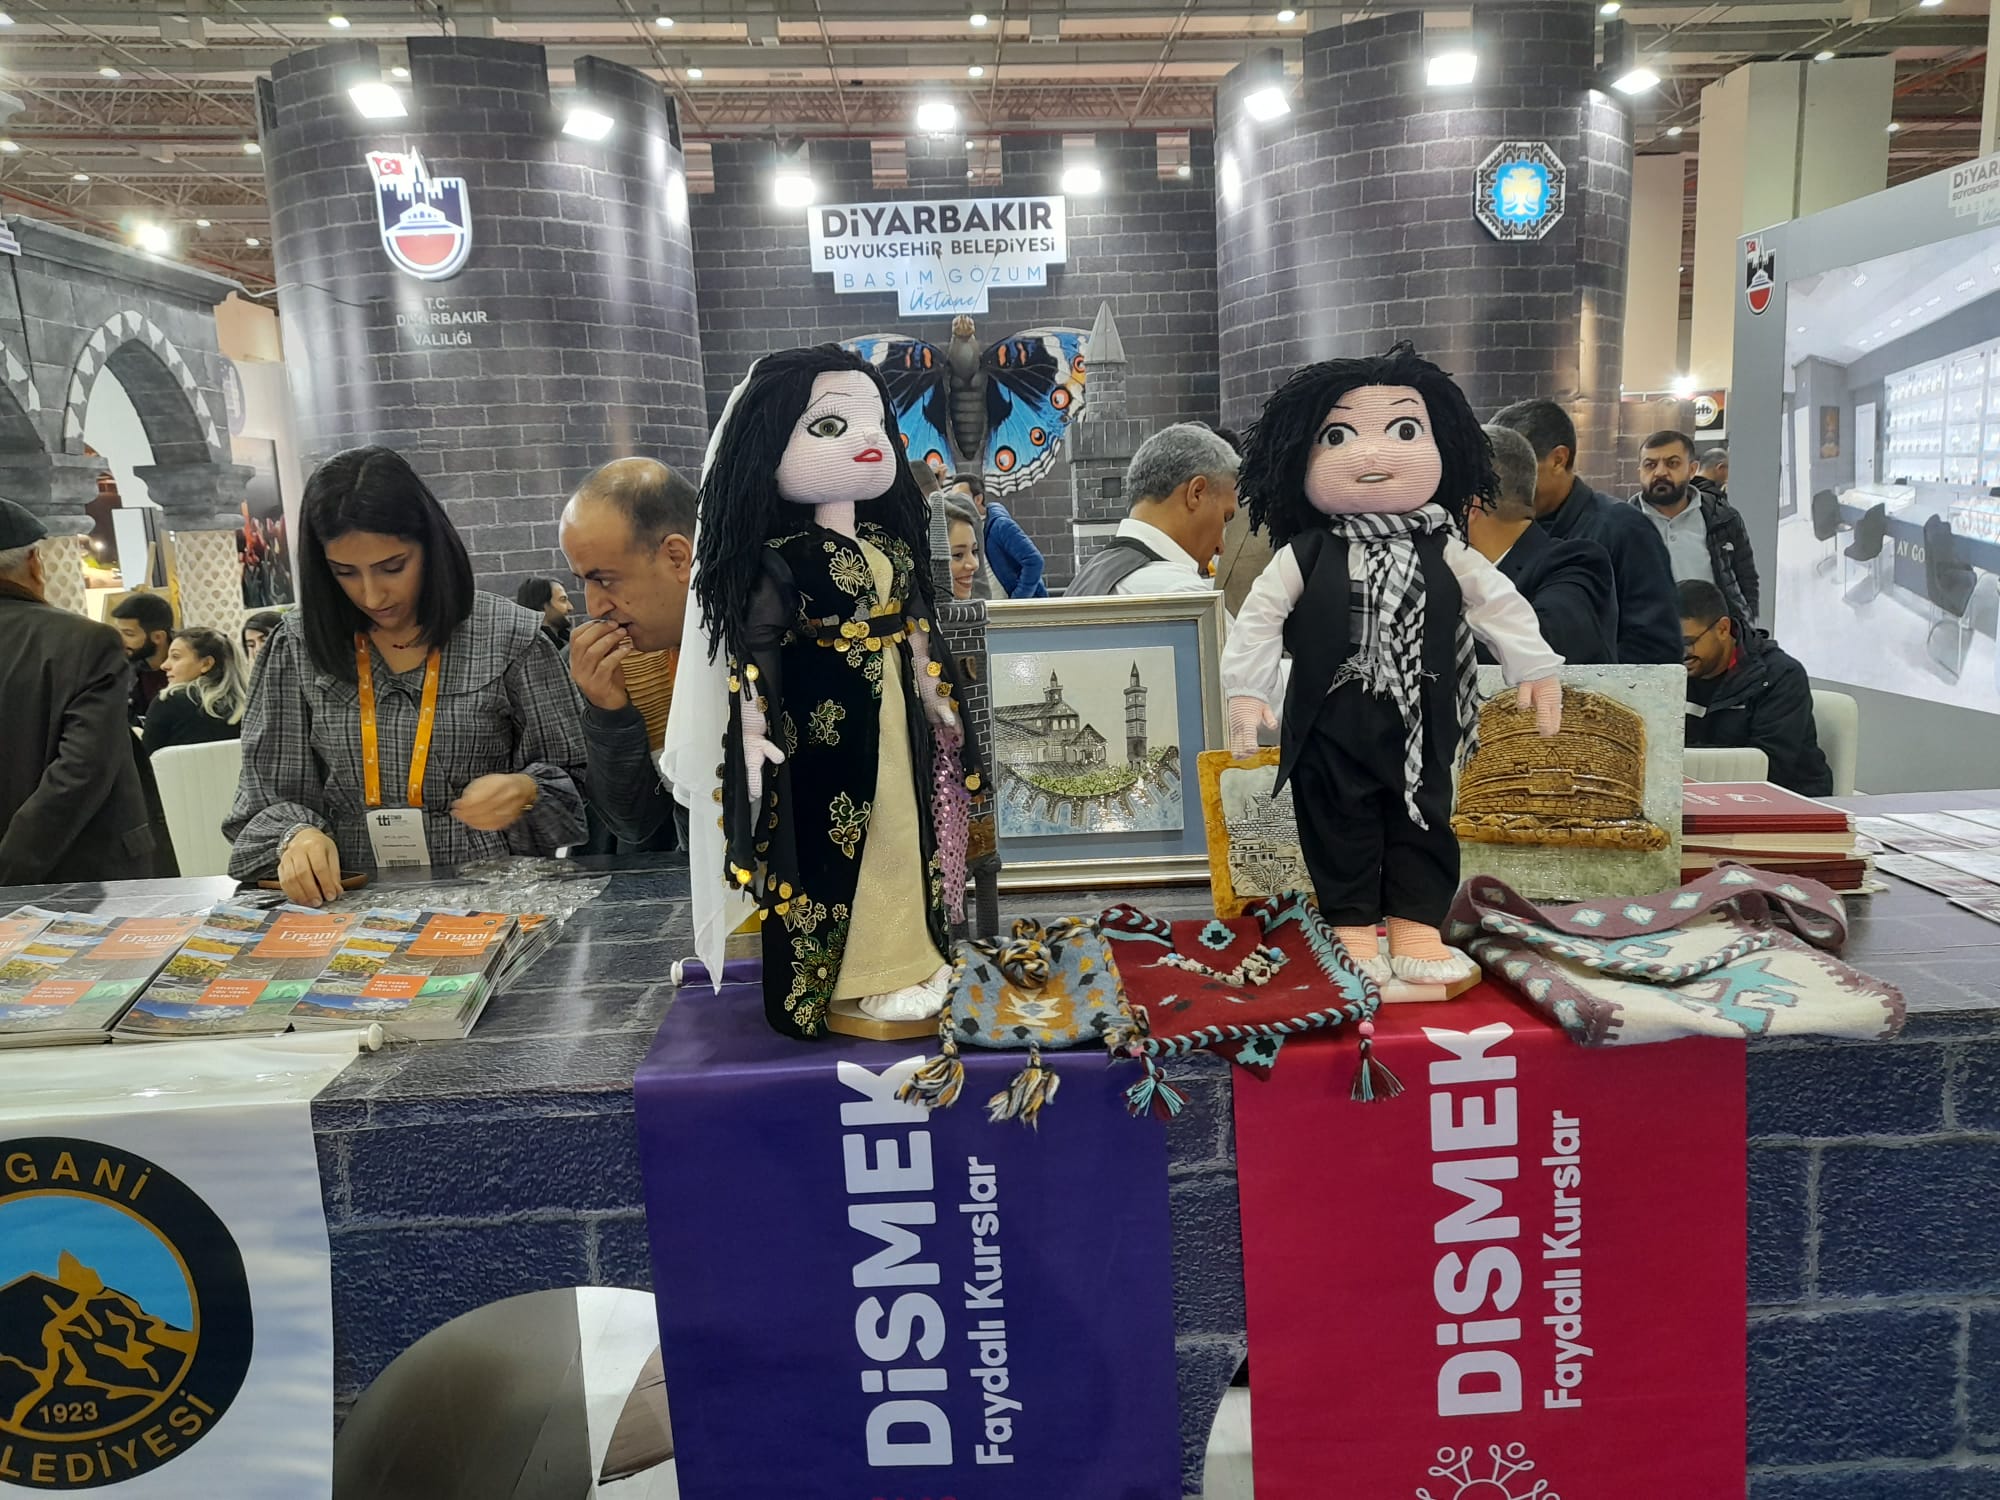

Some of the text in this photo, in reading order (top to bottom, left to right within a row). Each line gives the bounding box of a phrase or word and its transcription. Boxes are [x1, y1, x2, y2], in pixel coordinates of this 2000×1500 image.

[958, 1156, 1023, 1465] Faydalı Kurslar
[1541, 1110, 1594, 1410] Faydalı Kurslar
[38, 1399, 99, 1425] 1923
